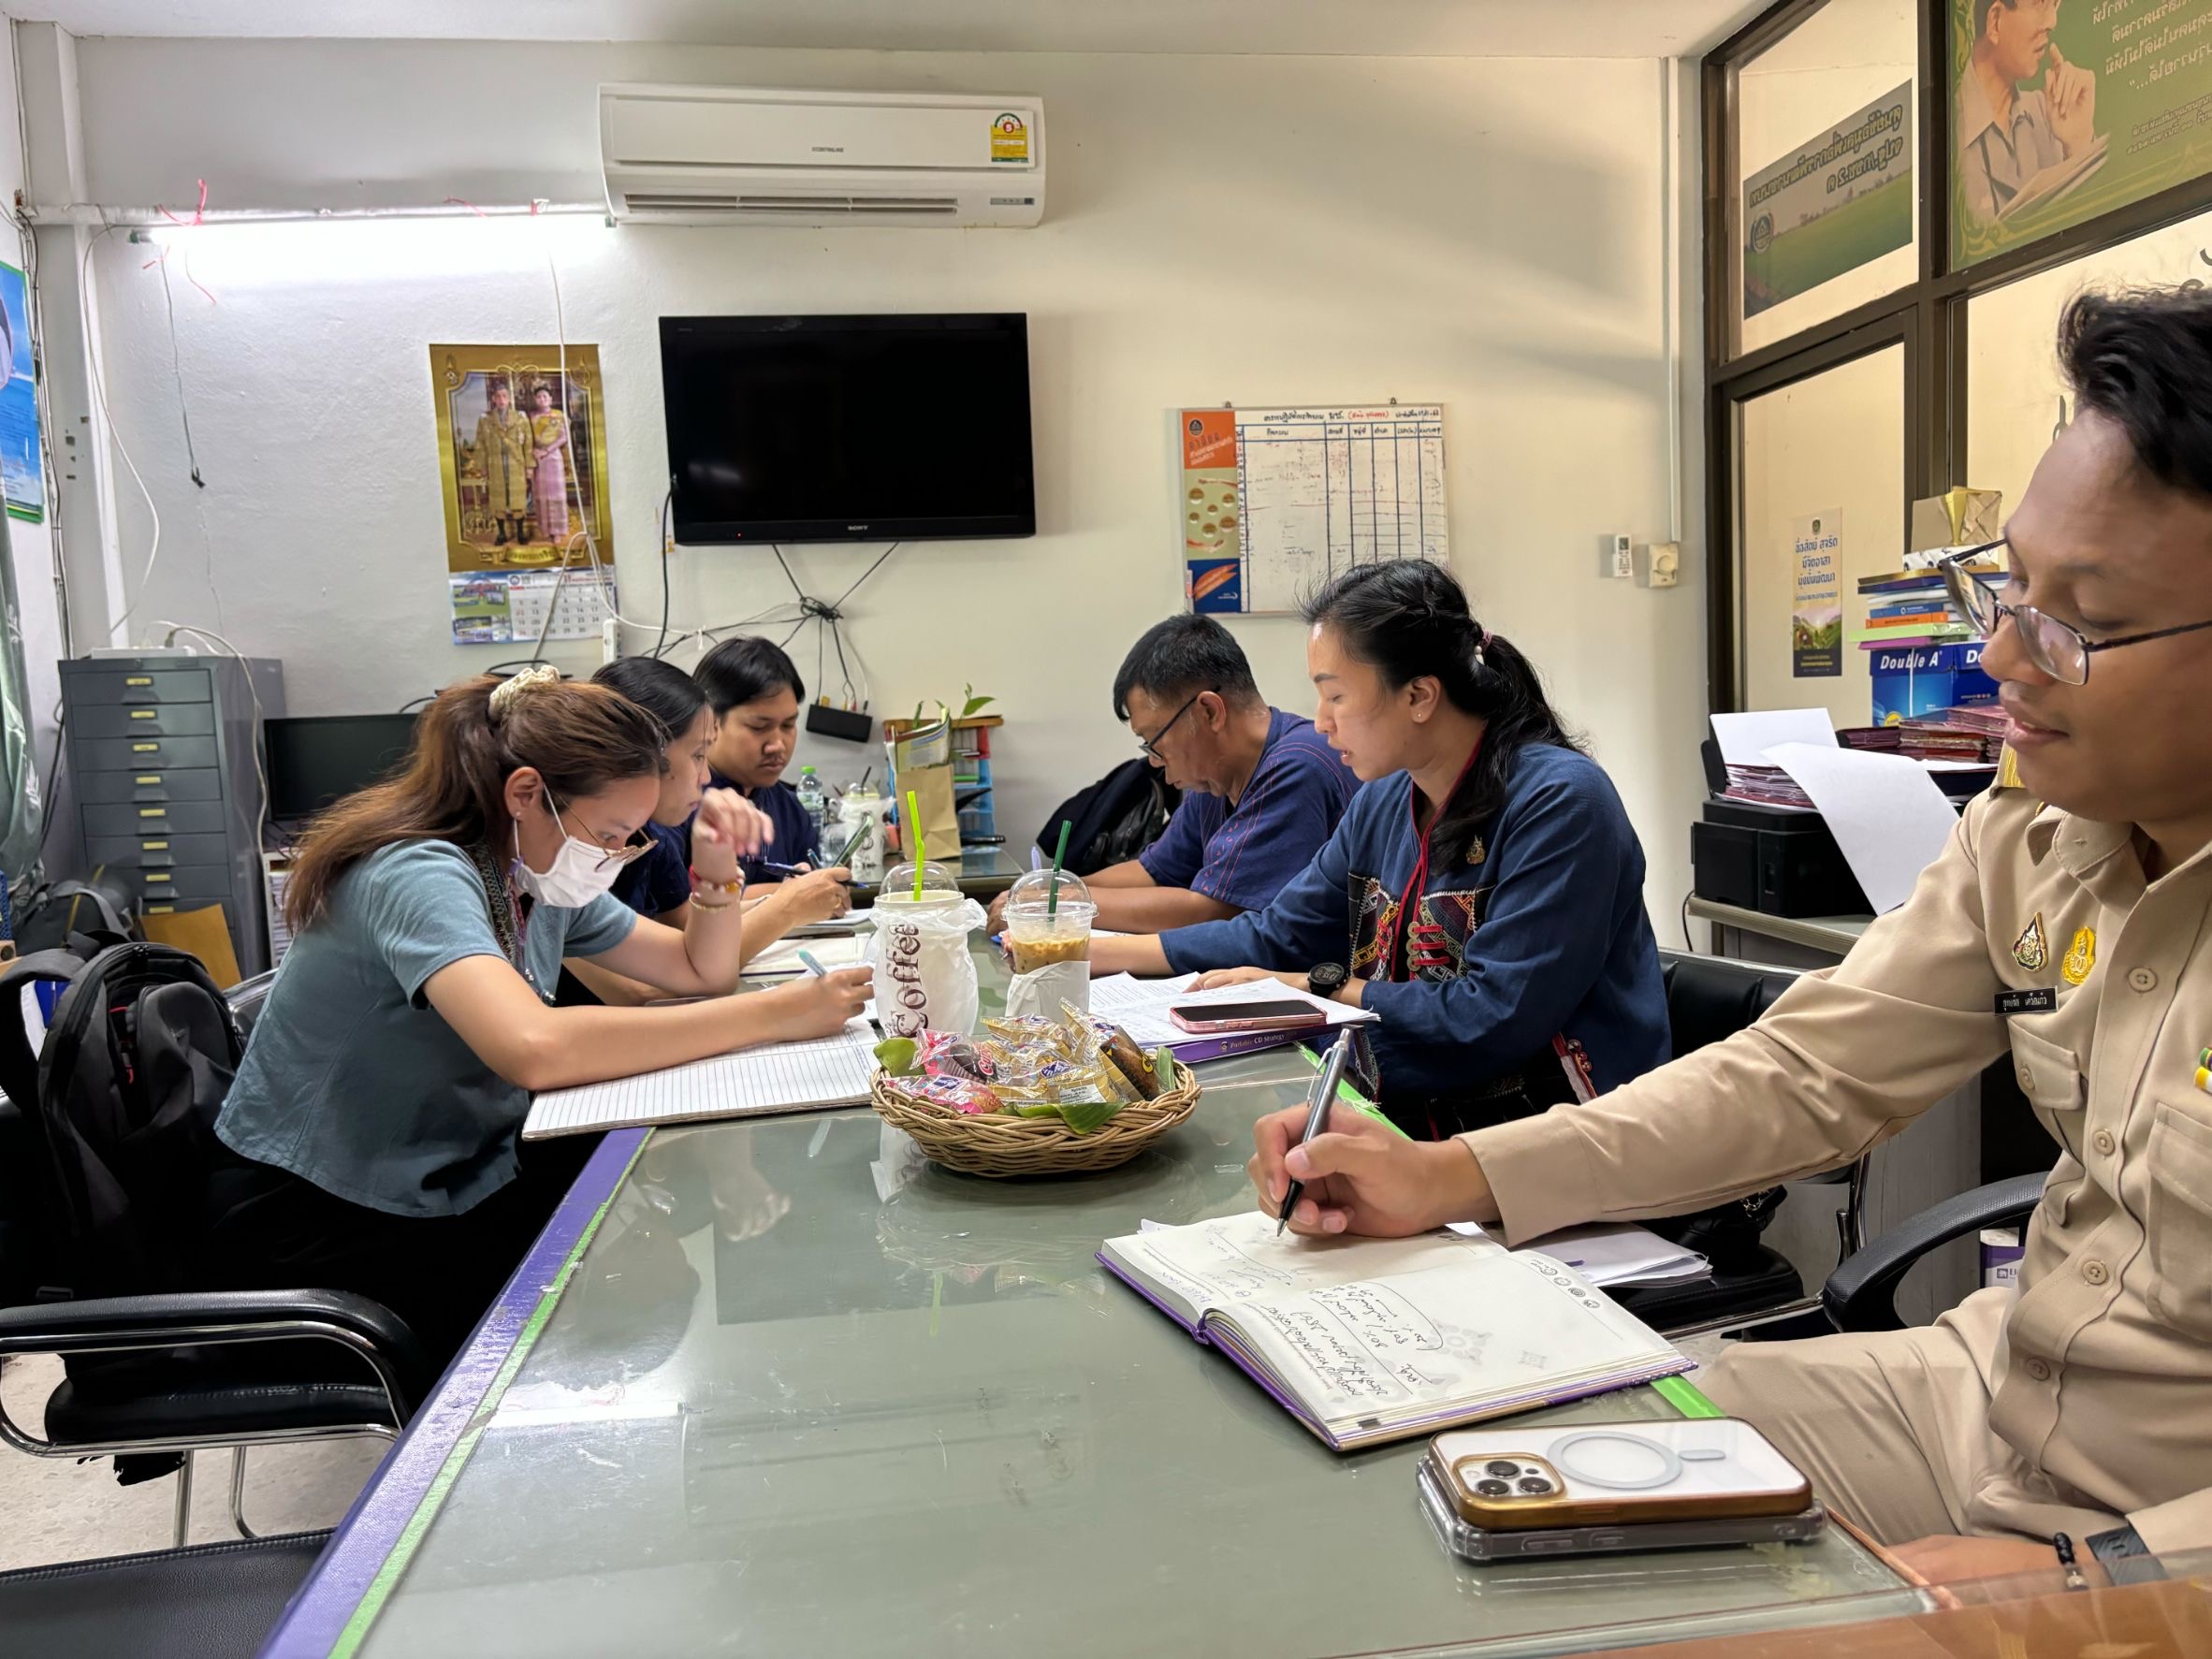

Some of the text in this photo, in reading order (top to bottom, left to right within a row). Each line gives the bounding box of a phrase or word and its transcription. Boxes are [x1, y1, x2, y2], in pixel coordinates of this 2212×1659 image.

[1796, 534, 1839, 553] ซื่อสัตย์ สุจริต
[1802, 555, 1831, 569] มีจิตอาสา
[1880, 651, 1939, 670] Double A
[892, 924, 929, 1039] Coffee
[1263, 1034, 1285, 1042] Strategy
